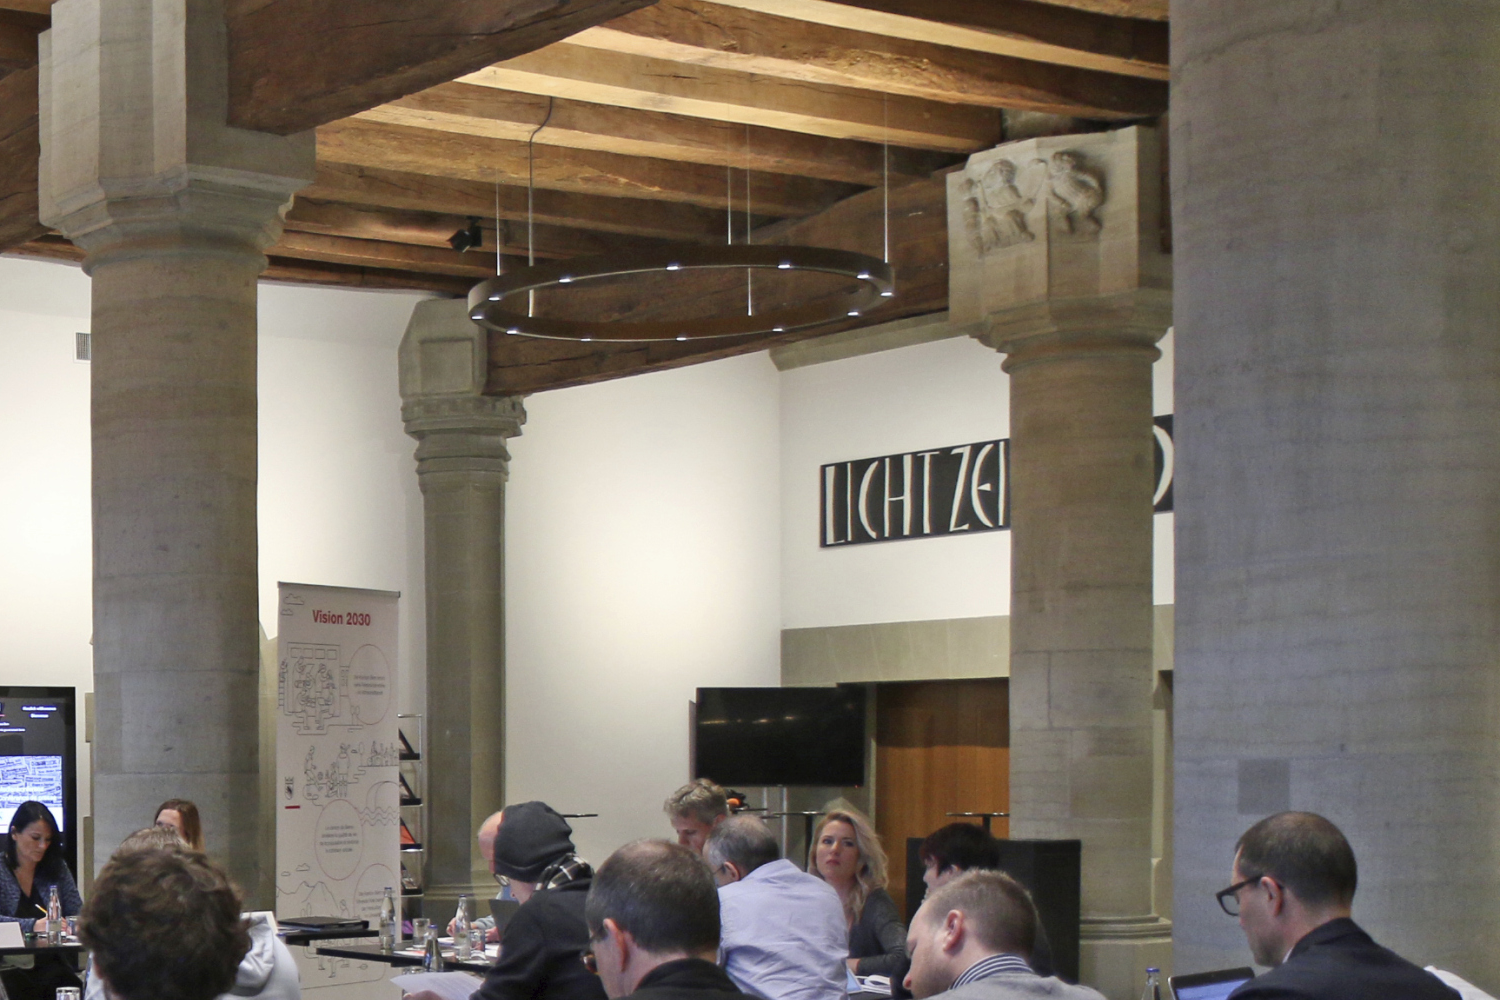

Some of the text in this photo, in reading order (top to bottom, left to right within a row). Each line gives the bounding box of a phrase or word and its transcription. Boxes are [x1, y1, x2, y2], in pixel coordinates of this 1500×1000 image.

[824, 451, 940, 546] LICHT
[312, 609, 371, 626] Vision 2030
